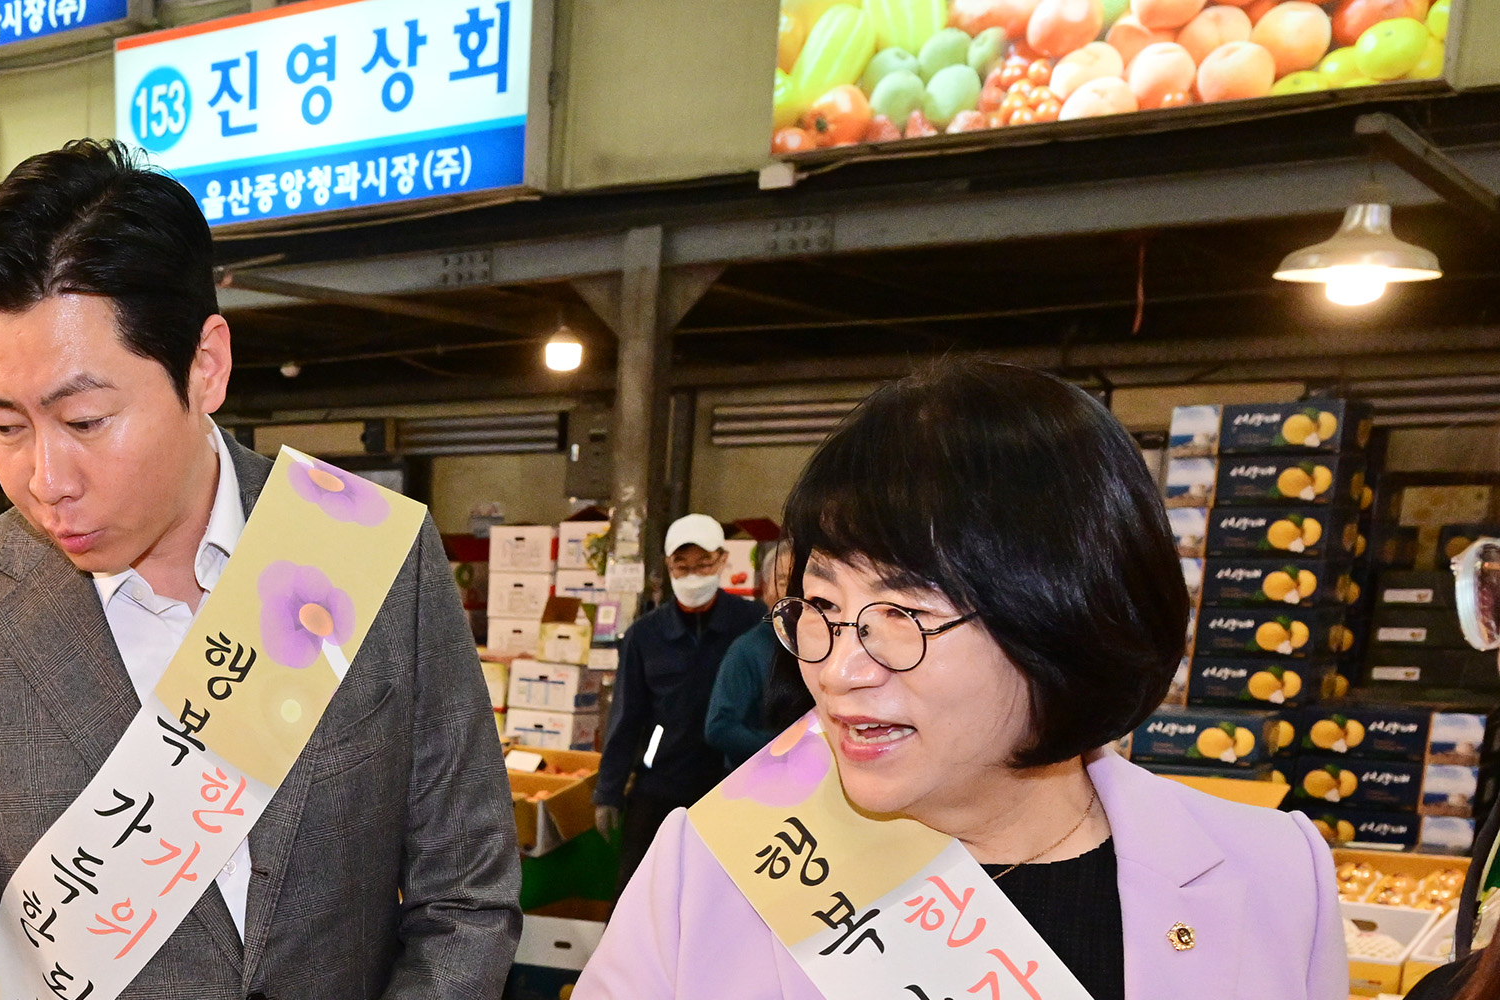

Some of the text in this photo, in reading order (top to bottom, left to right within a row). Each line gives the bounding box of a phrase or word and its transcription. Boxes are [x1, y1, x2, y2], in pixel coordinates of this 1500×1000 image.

[136, 2, 511, 139] 153 진영상회
[201, 144, 472, 220] 울산중앙청과시장(주)
[18, 631, 257, 949] 행복 가득한
[86, 766, 248, 960] 한가위
[753, 817, 886, 958] 행복
